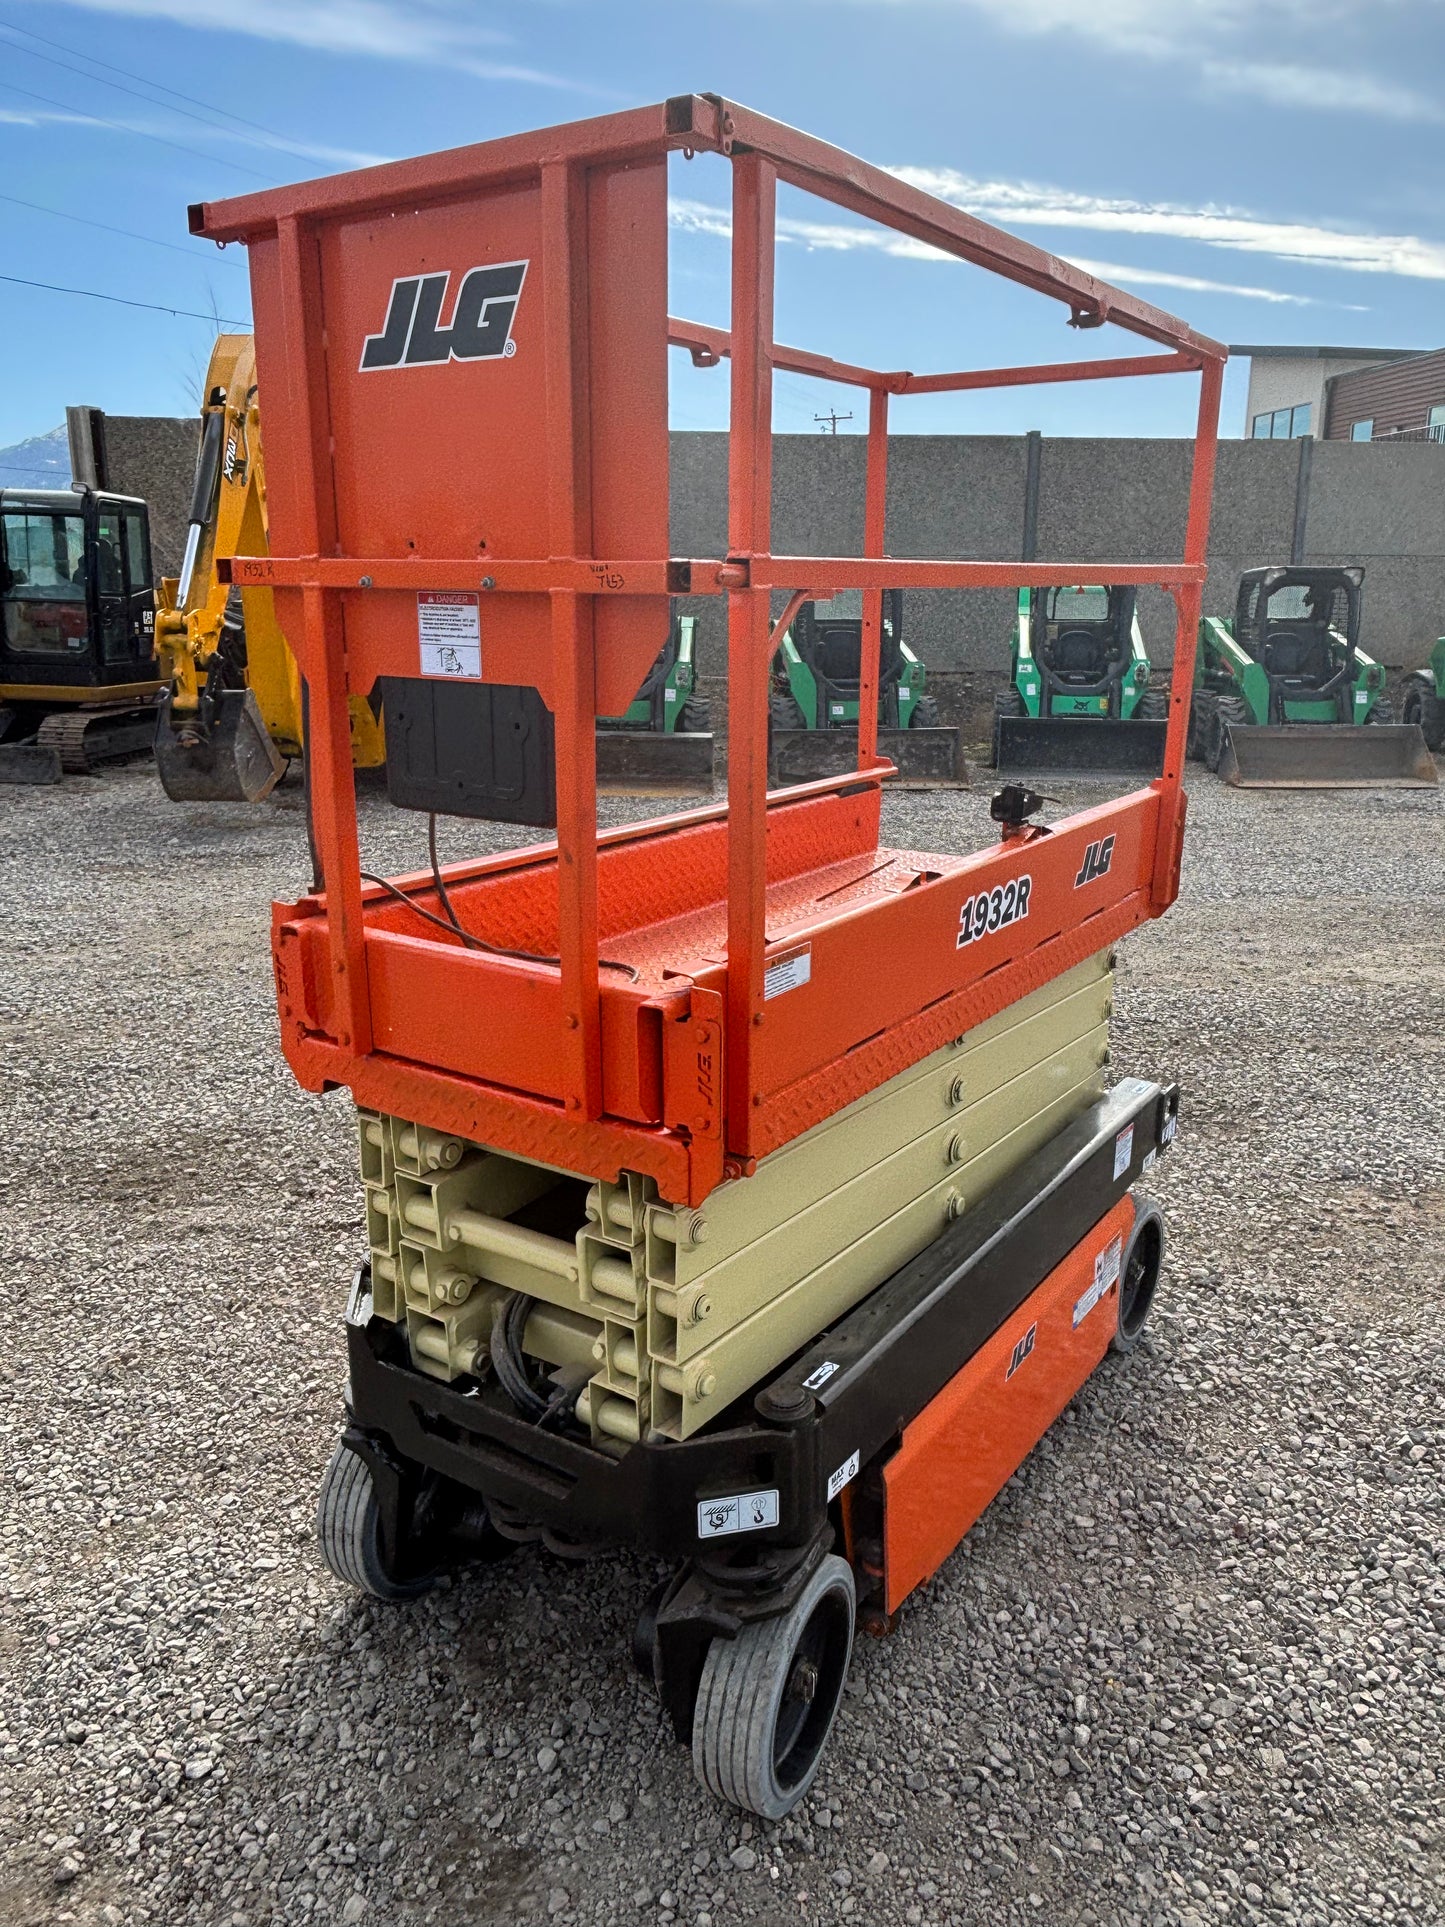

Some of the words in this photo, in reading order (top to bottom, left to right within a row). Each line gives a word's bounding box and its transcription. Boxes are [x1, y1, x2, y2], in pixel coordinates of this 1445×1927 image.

[436, 594, 468, 604] DANGER
[1074, 833, 1116, 889] JLG
[956, 874, 1032, 950] 1932R
[1005, 1321, 1037, 1382] JLG
